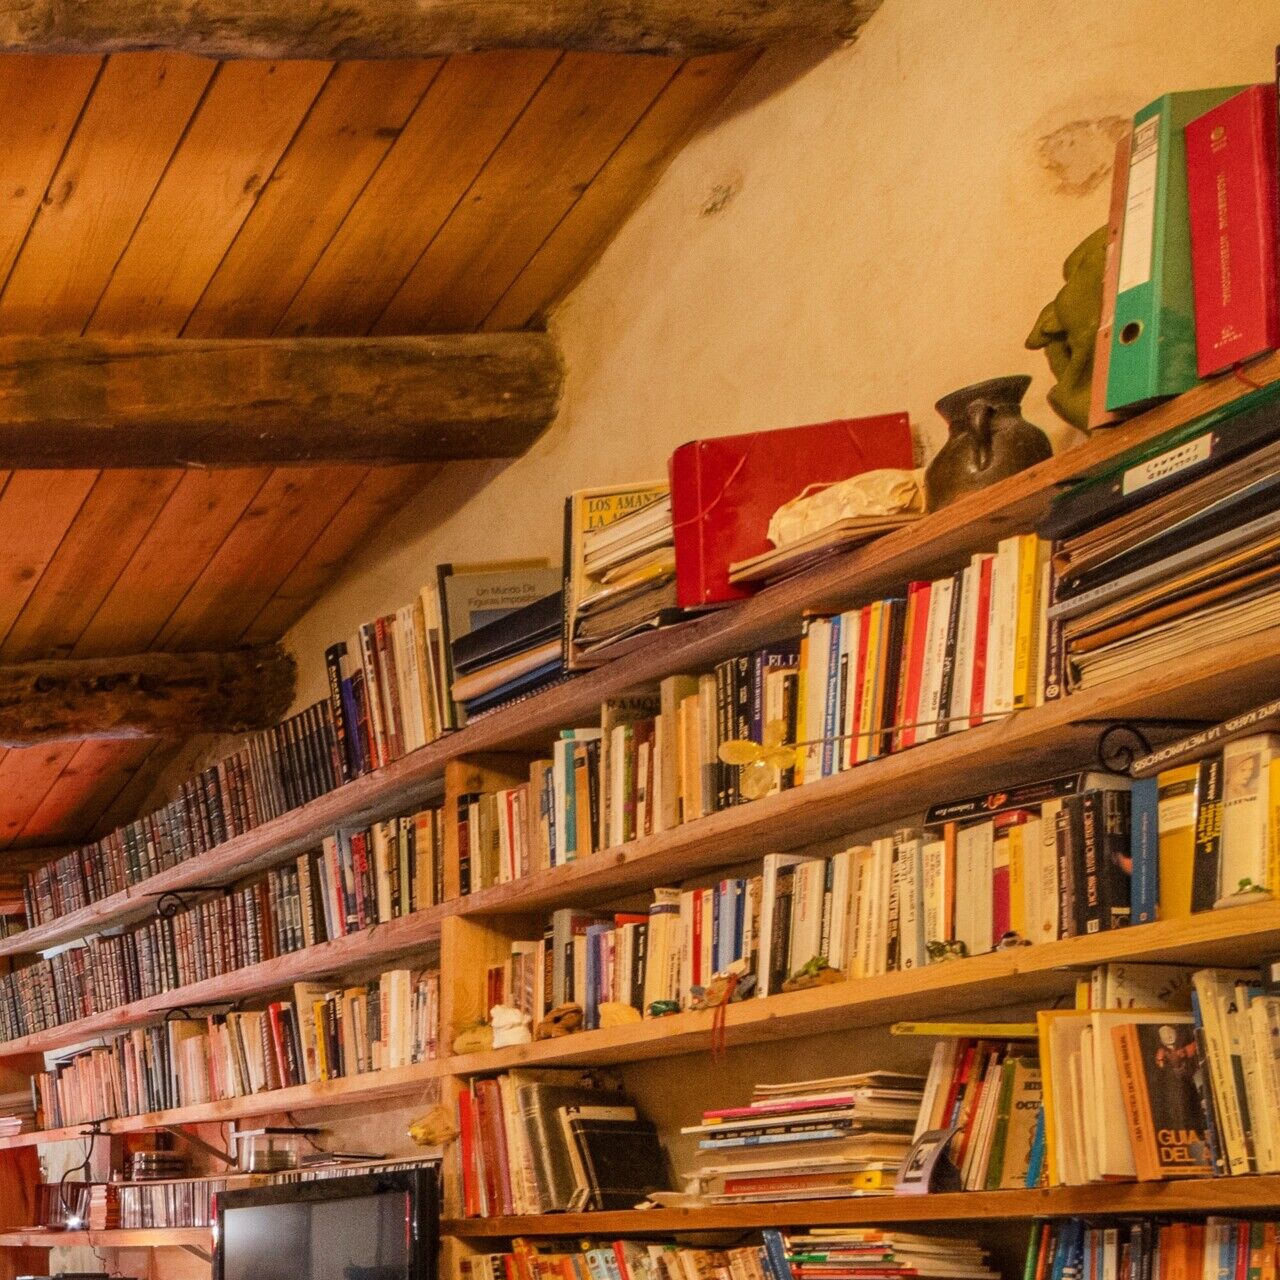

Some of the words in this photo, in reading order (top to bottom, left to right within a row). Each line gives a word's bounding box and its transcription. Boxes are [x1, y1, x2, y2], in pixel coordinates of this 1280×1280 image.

[588, 498, 611, 513] LOS
[1205, 730, 1221, 744] LA
[1158, 1128, 1197, 1146] GUIA
[1161, 1147, 1189, 1162] DEL
